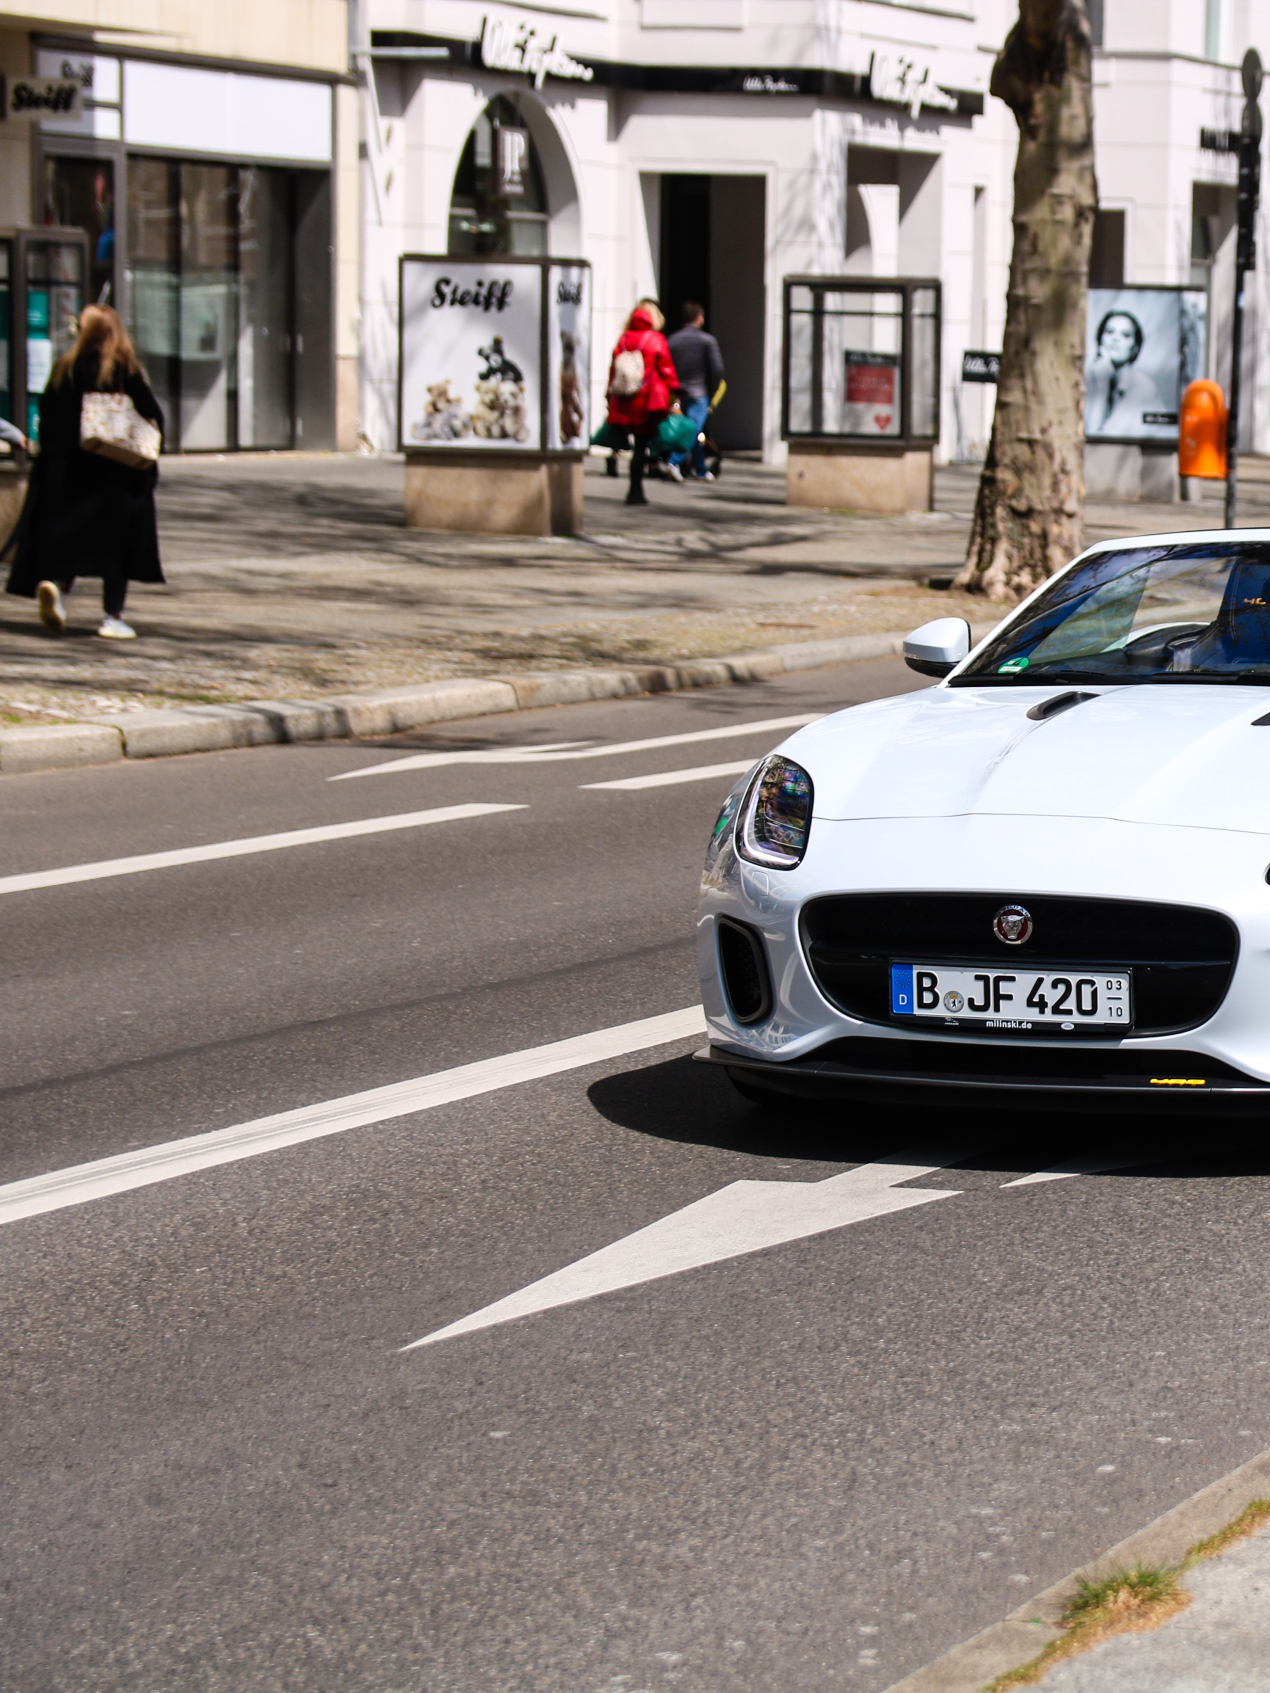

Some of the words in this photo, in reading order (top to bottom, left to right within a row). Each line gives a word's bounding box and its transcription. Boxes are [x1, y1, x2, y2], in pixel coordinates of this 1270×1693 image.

[431, 276, 514, 313] Steiff
[1106, 979, 1122, 990] 03
[899, 993, 908, 1006] D
[916, 971, 941, 1010] B
[967, 973, 1016, 1013] JF
[1026, 976, 1099, 1016] 420
[1107, 1006, 1123, 1017] 10
[986, 1019, 1033, 1030] milinski.de
